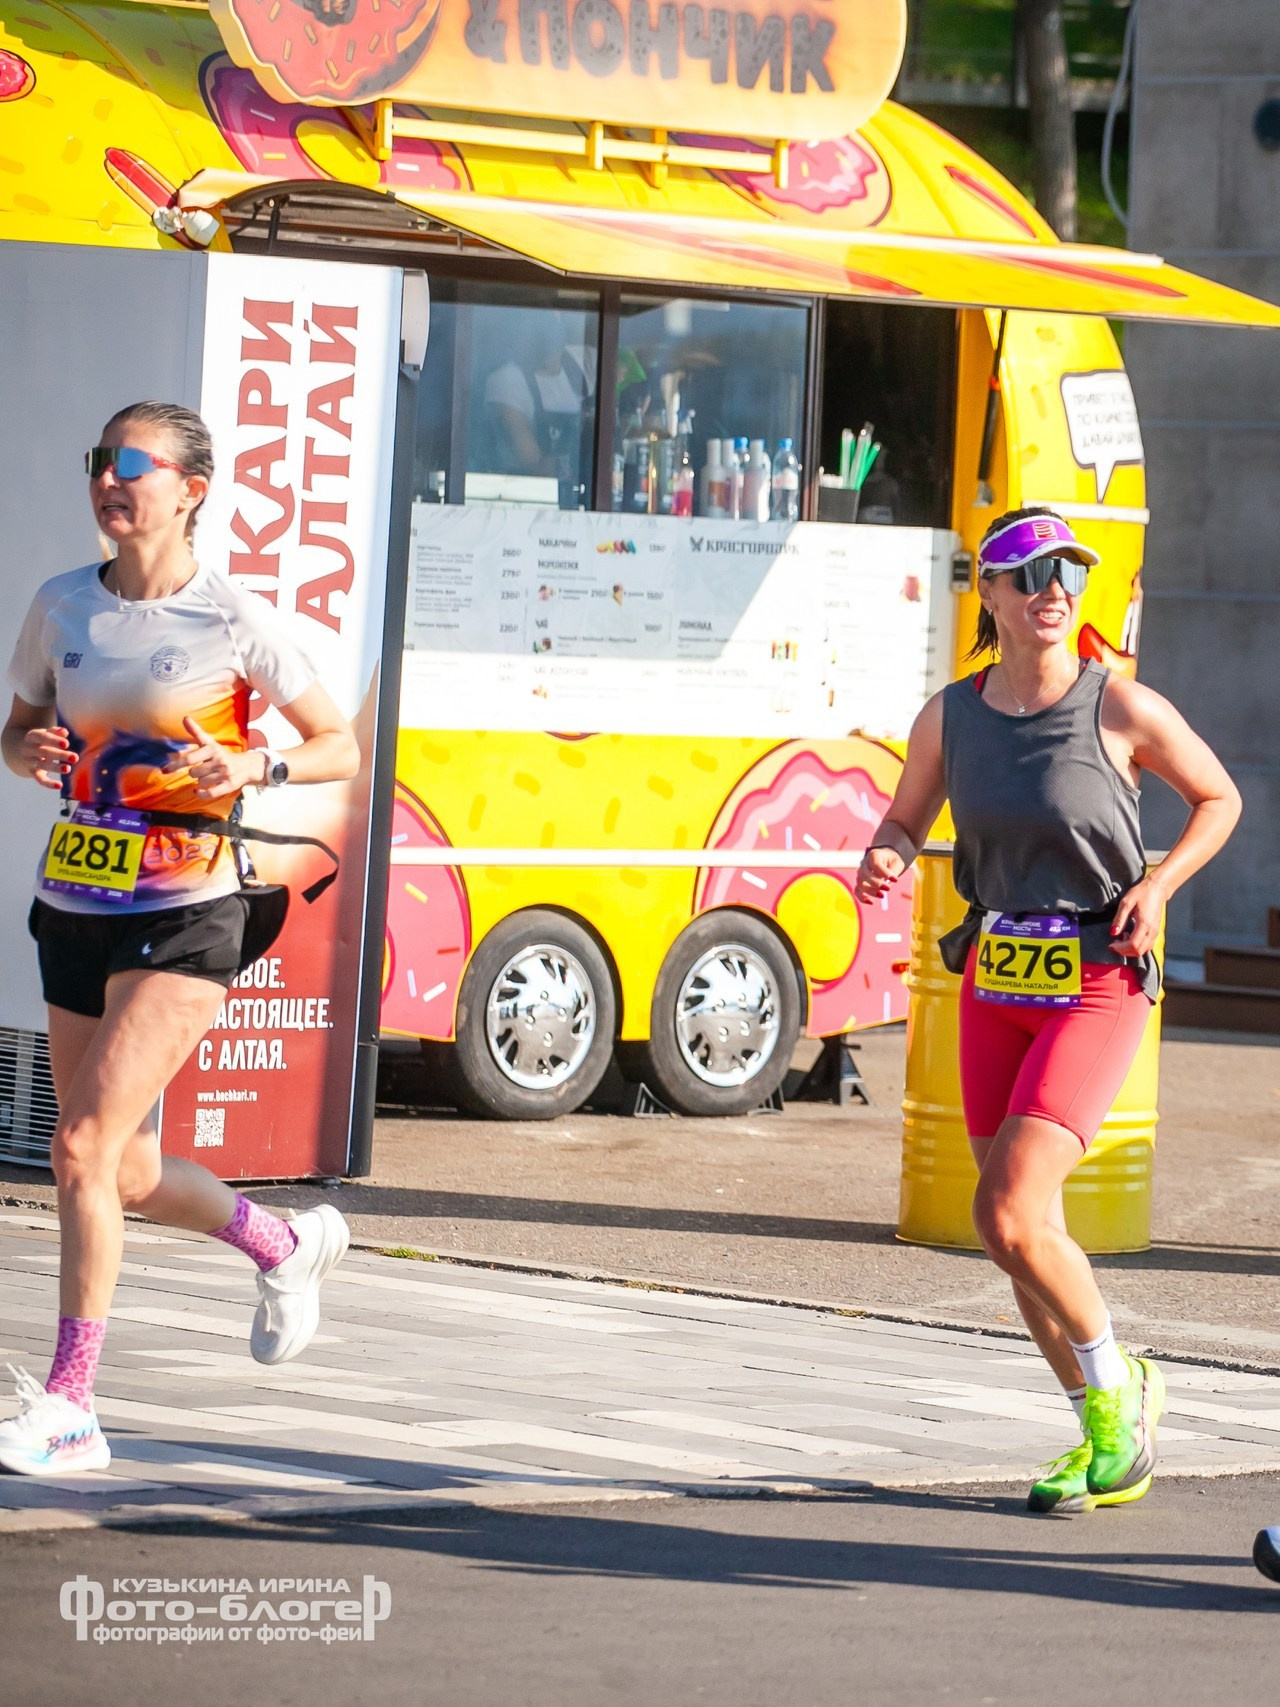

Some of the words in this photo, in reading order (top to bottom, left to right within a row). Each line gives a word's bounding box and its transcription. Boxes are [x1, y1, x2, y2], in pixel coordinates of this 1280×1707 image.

[517, 0, 836, 94] ПОНЧИК
[229, 296, 295, 609] КАРИ
[295, 302, 359, 635] АЛТАЙ
[53, 829, 131, 875] 4281
[232, 957, 286, 989] ВОЕ.
[978, 940, 1073, 981] 4276
[1024, 981, 1059, 990] НАТАЛЬЯ
[208, 998, 334, 1032] АСТОЯЩЕЕ.
[198, 1039, 213, 1071] С
[217, 1038, 288, 1071] АЛТАЯ.
[197, 1089, 258, 1102] www.bochkari.ru
